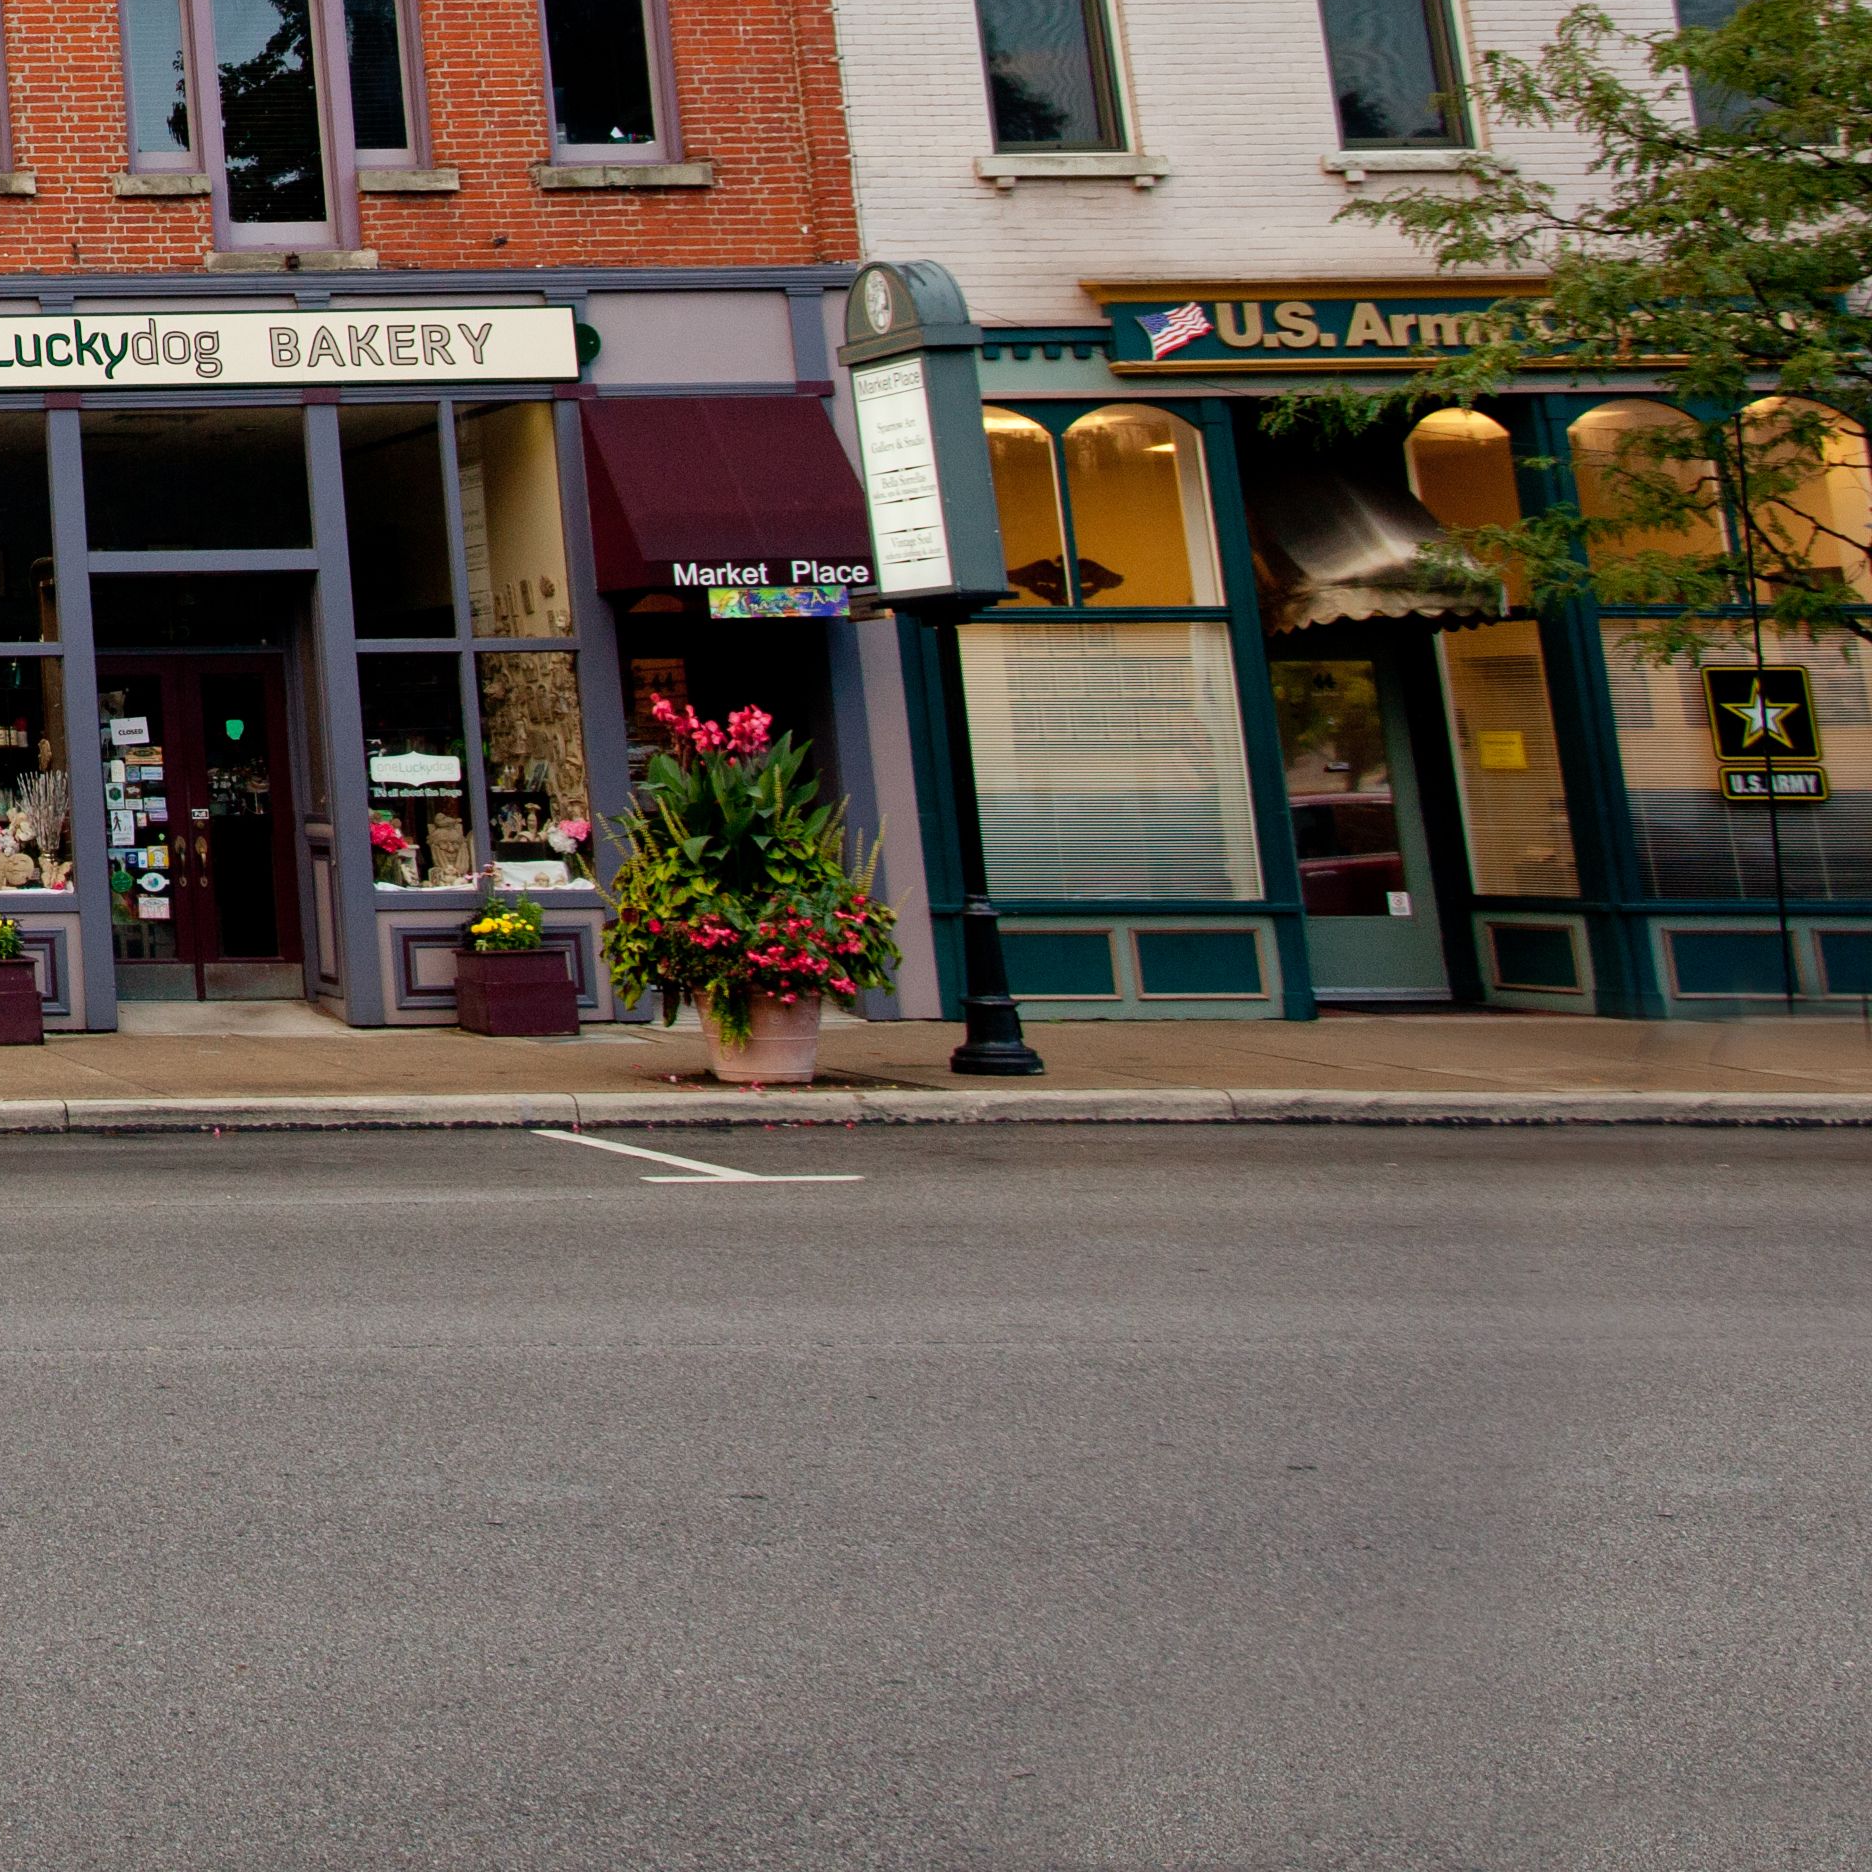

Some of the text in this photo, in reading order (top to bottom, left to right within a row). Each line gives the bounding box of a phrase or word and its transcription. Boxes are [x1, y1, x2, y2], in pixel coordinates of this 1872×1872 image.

[1214, 302, 1337, 349] U.S.
[269, 323, 493, 367] BAKERY
[858, 371, 920, 396] Market Place
[673, 560, 870, 586] Market Place
[1729, 774, 1768, 794] U.S.
